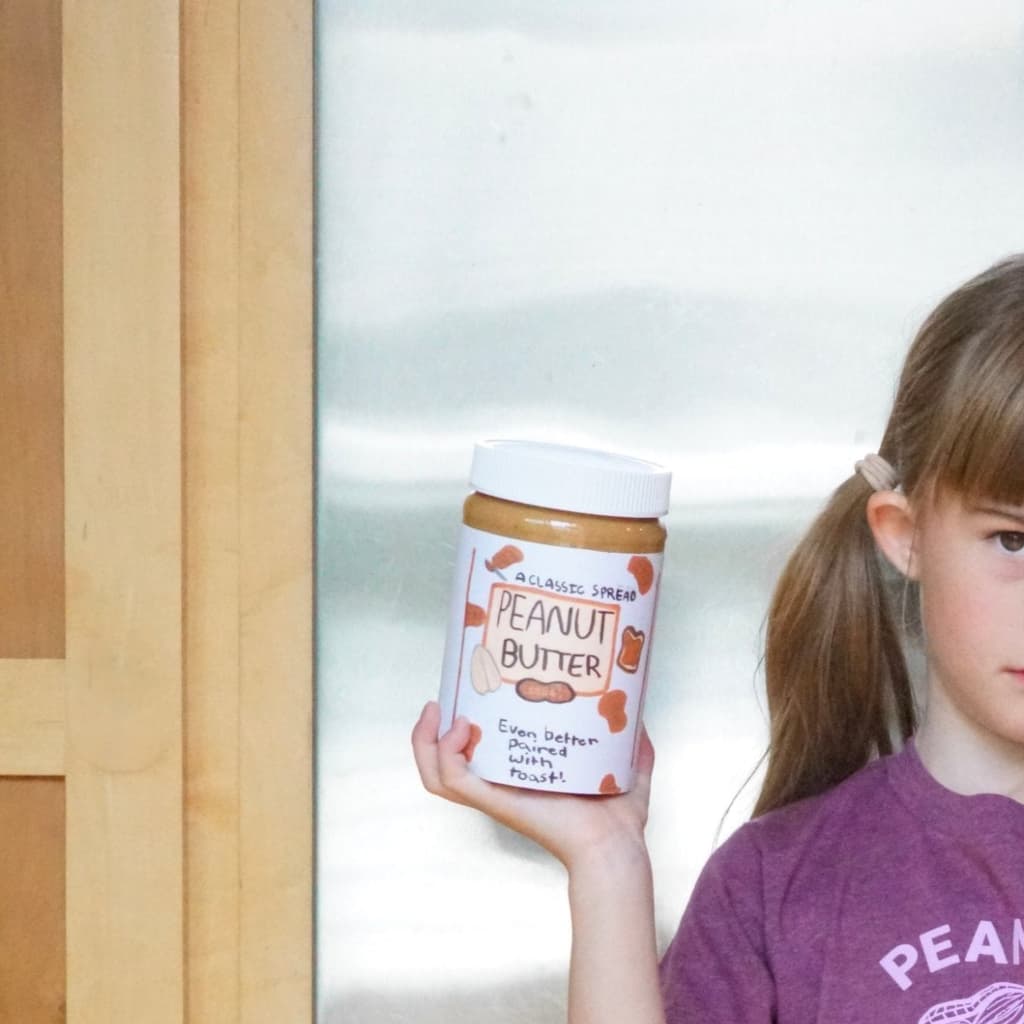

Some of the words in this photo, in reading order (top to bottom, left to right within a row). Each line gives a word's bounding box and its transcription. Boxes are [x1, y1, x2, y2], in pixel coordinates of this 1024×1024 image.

[529, 574, 584, 594] CLASSIC
[592, 585, 637, 602] SPREAD
[497, 590, 615, 645] PEANUT
[501, 638, 602, 678] BUTTER
[499, 719, 537, 739] Even
[545, 724, 599, 746] better
[510, 767, 567, 784] toast!
